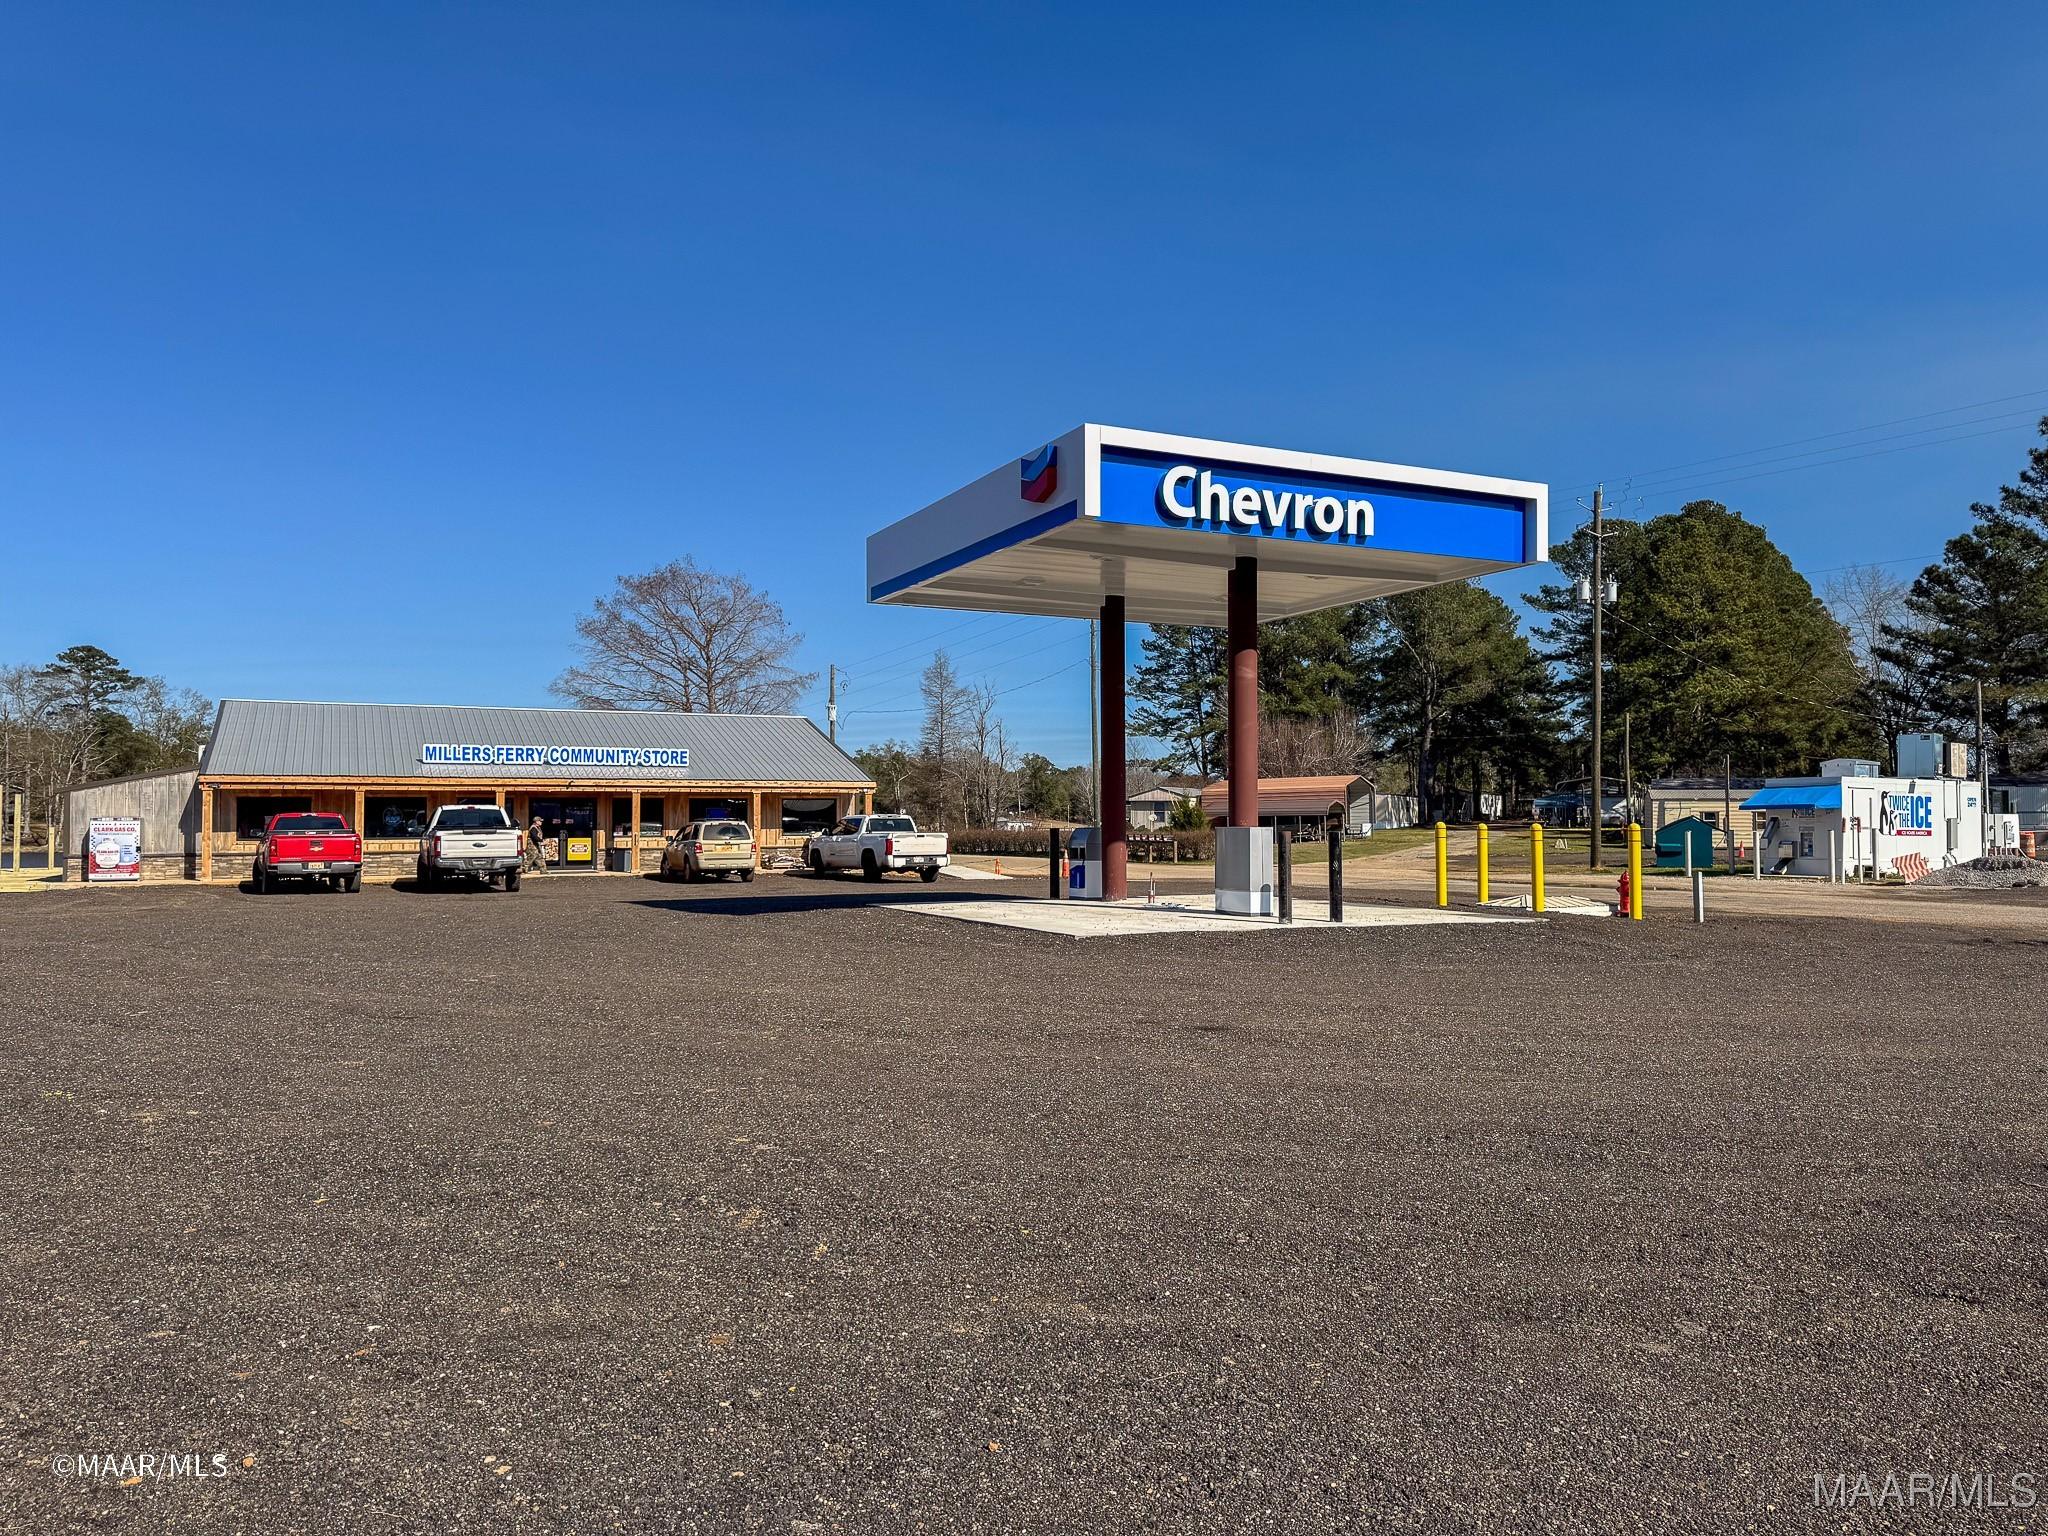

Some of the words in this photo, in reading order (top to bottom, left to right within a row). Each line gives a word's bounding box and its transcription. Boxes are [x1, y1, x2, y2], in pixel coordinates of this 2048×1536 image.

[1161, 466, 1375, 536] Chevron
[425, 745, 491, 761] MILLERS
[496, 747, 545, 762] FERRY
[550, 748, 639, 763] COMMUNITY
[643, 749, 688, 764] STORE
[1889, 795, 1909, 811] TWICE
[1910, 796, 1932, 828] ICE
[1898, 813, 1910, 828] THE
